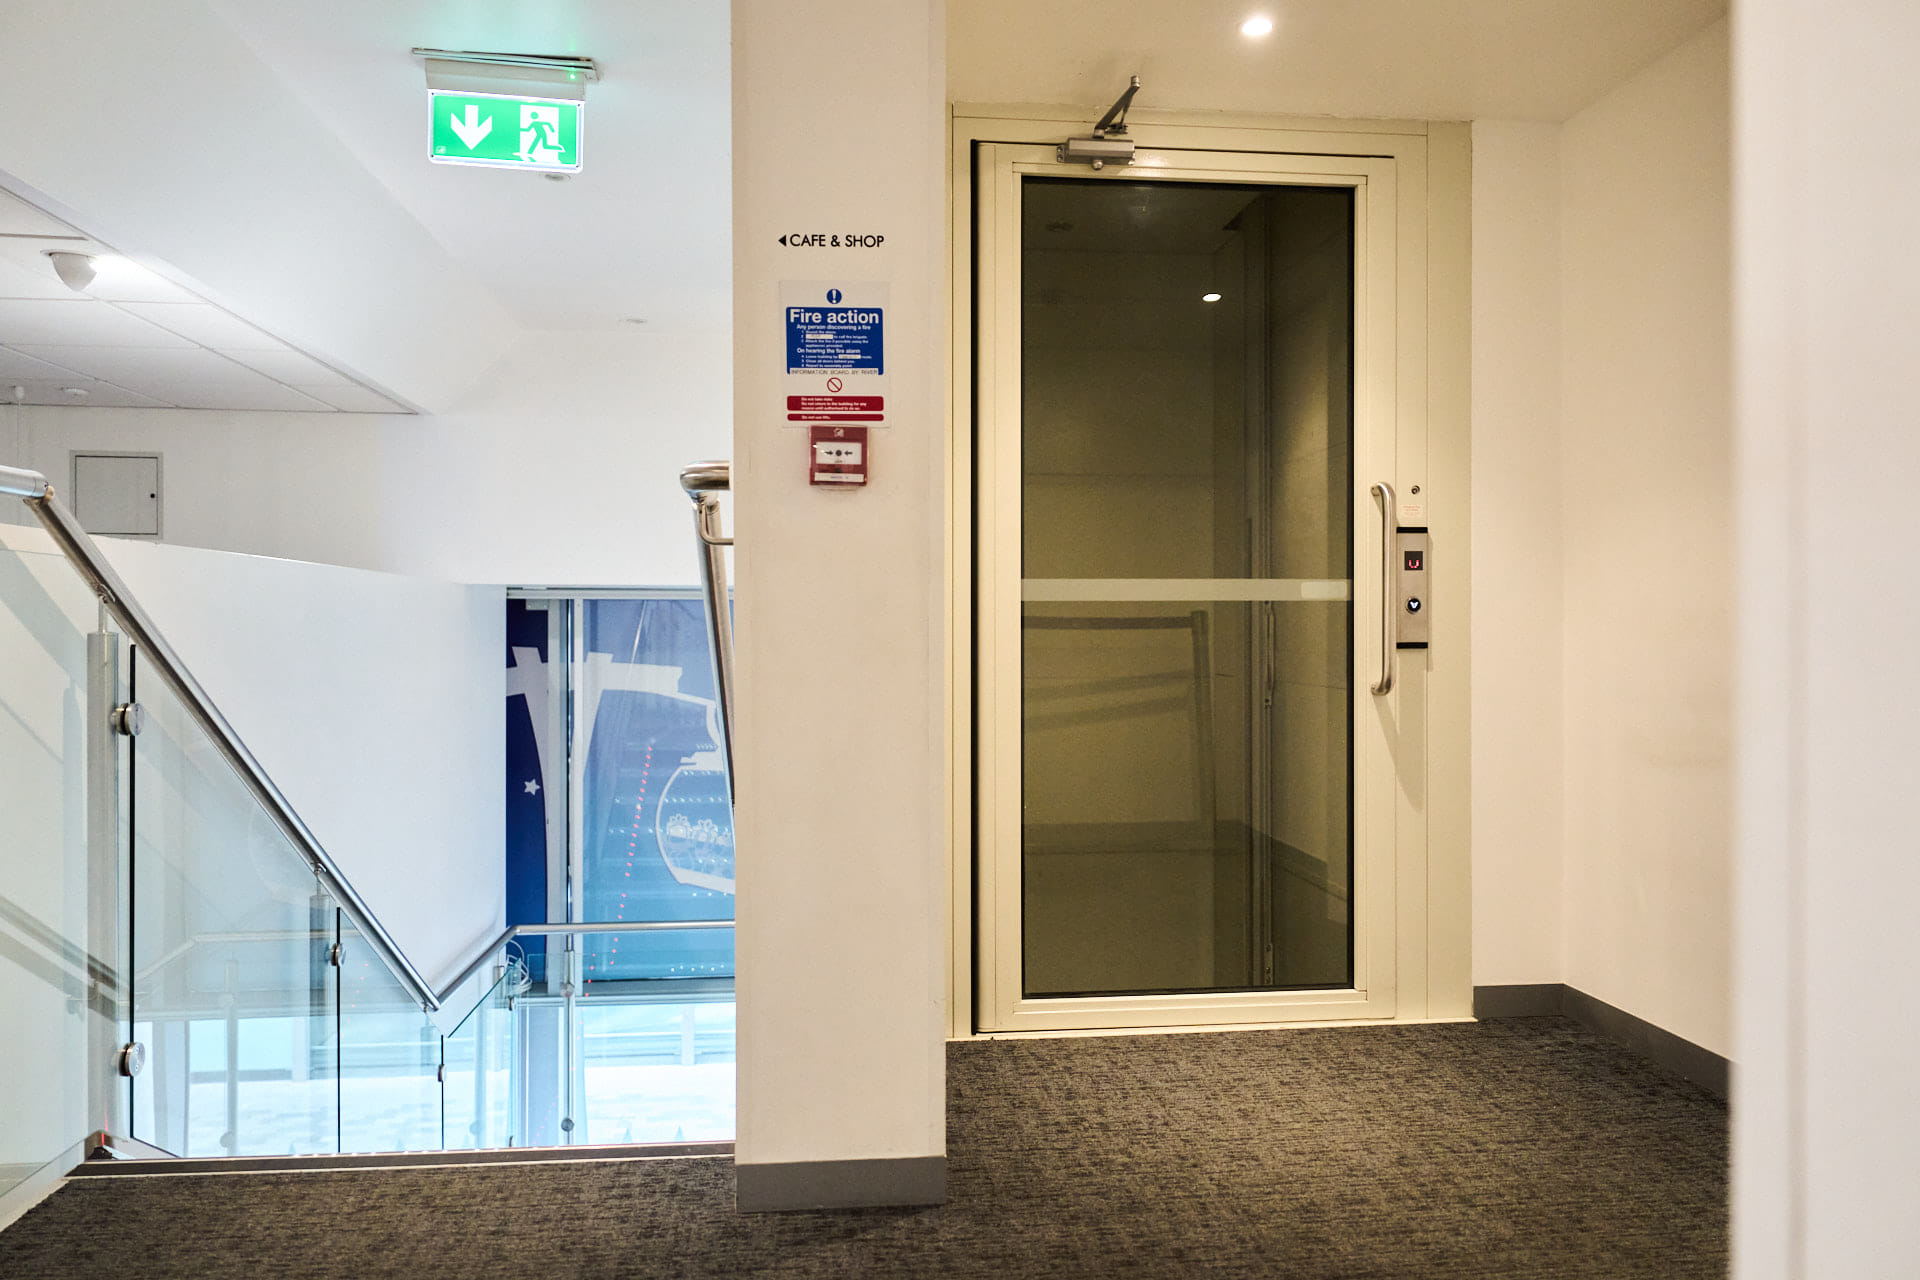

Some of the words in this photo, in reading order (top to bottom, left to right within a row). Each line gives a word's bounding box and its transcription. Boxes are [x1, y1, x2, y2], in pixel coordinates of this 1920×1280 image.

[790, 234, 826, 246] CAFE
[830, 235, 840, 247] &
[845, 235, 884, 248] SHOP
[790, 308, 822, 323] Fire
[827, 310, 879, 324] action
